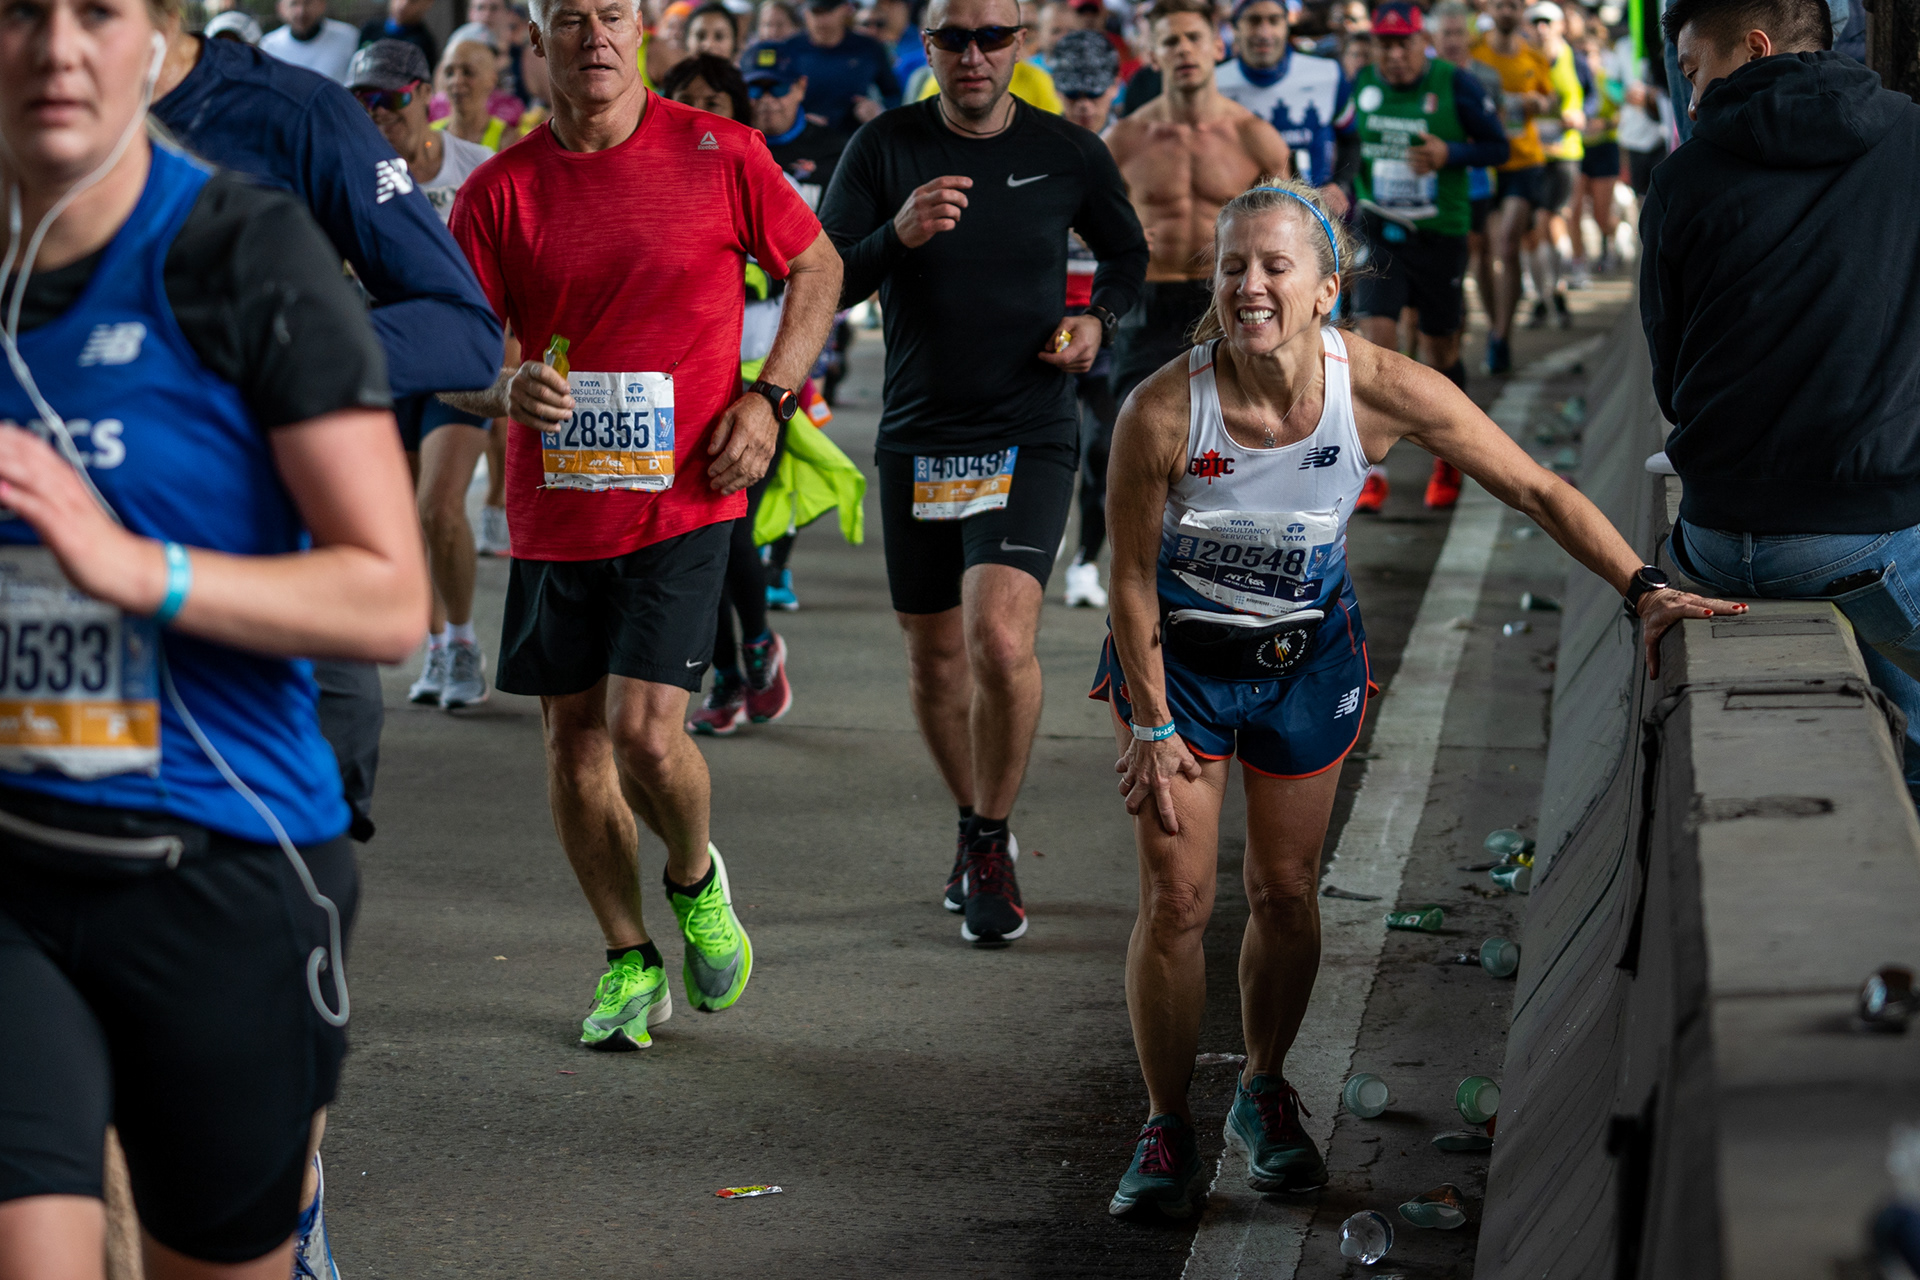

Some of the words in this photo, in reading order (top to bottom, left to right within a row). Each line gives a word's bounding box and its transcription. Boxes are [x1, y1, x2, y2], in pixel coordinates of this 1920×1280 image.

[579, 380, 601, 388] TATA
[570, 388, 614, 396] ONSULTANCY
[564, 411, 650, 448] 28355
[1211, 526, 1271, 535] CONSULTANCY
[1221, 533, 1259, 541] SERVICES
[1176, 537, 1194, 558] 2019
[1199, 540, 1306, 576] 20548
[1273, 660, 1294, 669] CITY
[1152, 723, 1176, 737] OST-R
